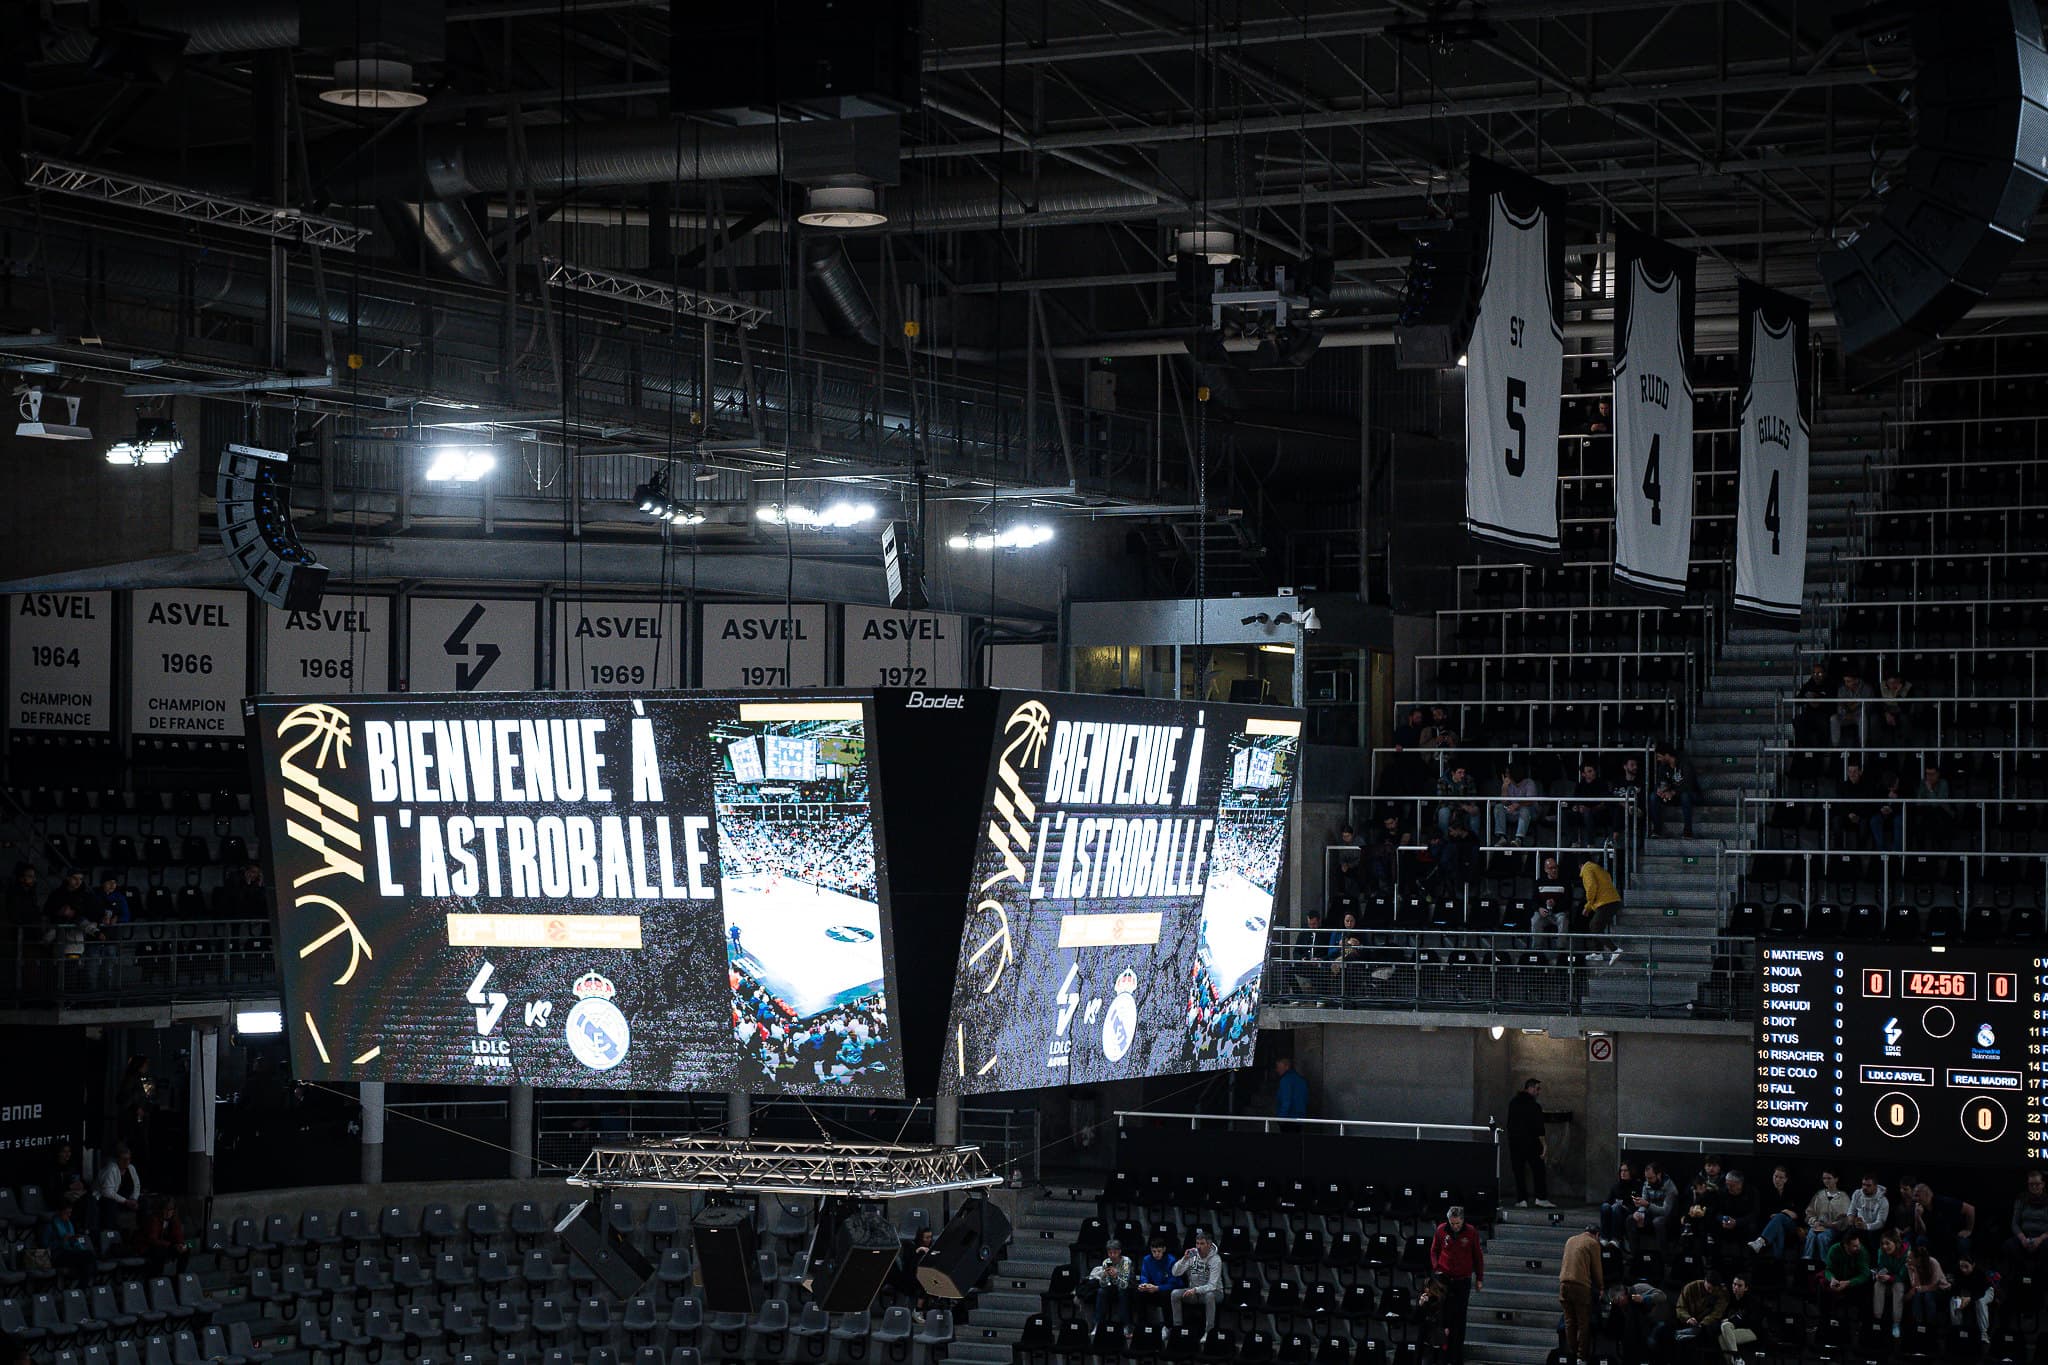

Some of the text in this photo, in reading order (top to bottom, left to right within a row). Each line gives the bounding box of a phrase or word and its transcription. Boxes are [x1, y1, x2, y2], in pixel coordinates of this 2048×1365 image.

[1510, 316, 1525, 348] SY
[1640, 374, 1670, 411] RUDD
[1505, 376, 1526, 478] 5
[1758, 415, 1791, 450] GILLES
[1642, 433, 1662, 526] 4
[1765, 469, 1781, 556] 4
[20, 592, 95, 620] ASVEL
[148, 602, 229, 627] ASVEL
[285, 607, 371, 633] ASVEL
[575, 616, 663, 640] ASVEL
[721, 619, 807, 641] ASVEL
[862, 619, 945, 641] ASVEL
[32, 646, 80, 668] 1964
[161, 653, 213, 675] 1966
[300, 658, 353, 680] 1968
[590, 664, 645, 685] 1969
[879, 667, 927, 686] 1972
[741, 667, 785, 687] 1971
[20, 692, 92, 707] CHAMPION
[148, 698, 226, 713] CHAMPION
[905, 691, 965, 709] Bodet
[21, 711, 91, 726] DE FRANCE
[150, 717, 225, 731] DE FRANCE
[365, 698, 665, 803] BIENVENUE À
[1044, 709, 1206, 806] BIENVENUE À
[373, 808, 716, 900] L'ASTROBALLE
[1029, 810, 1215, 901] L'ASTROBALLE
[1763, 950, 1844, 962] 0 MATHEWS 0
[2033, 958, 2041, 968] 0
[1763, 967, 1844, 979] 2 NOUA 0
[2034, 976, 2040, 985] 1
[1763, 983, 1844, 995] 3 BOST 0
[1870, 973, 1883, 993] 0
[1910, 974, 1965, 996] 42:56
[1995, 976, 2008, 997] 0
[2033, 992, 2041, 1002] 6
[1763, 1000, 1844, 1012] 5 KAHUDI 0
[1763, 1016, 1843, 1029] 8 DIOT 0
[2033, 1010, 2041, 1020] 8
[1762, 1033, 1843, 1046] 9 TYUS 0
[2029, 1027, 2040, 1037] 11
[472, 1040, 510, 1055] LDLC
[1049, 1041, 1072, 1055] LDLC
[2028, 1044, 2041, 1054] 13
[473, 1056, 512, 1067] ASVEL
[1757, 1050, 1843, 1063] 10 RISACHER 0
[1757, 1067, 1843, 1080] 12 DE COLO 0
[2028, 1062, 2041, 1071] 14
[1868, 1071, 1926, 1082] LDLC ASVEL
[1955, 1075, 2018, 1087] REAL MADRID
[2028, 1079, 2041, 1089] 17
[1757, 1083, 1843, 1097] 19 FALL 0
[1757, 1100, 1843, 1114] 23 LIGHTY 0
[2027, 1096, 2040, 1106] 21
[1, 1104, 42, 1121] anne
[1890, 1103, 1904, 1126] 0
[1978, 1107, 1992, 1130] 0
[2027, 1114, 2041, 1123] 22
[1756, 1117, 1843, 1131] 32 OBASOHAN 0
[1756, 1134, 1843, 1147] 35 PONS 0
[2027, 1131, 2041, 1141] 30
[2027, 1148, 2040, 1158] 31
